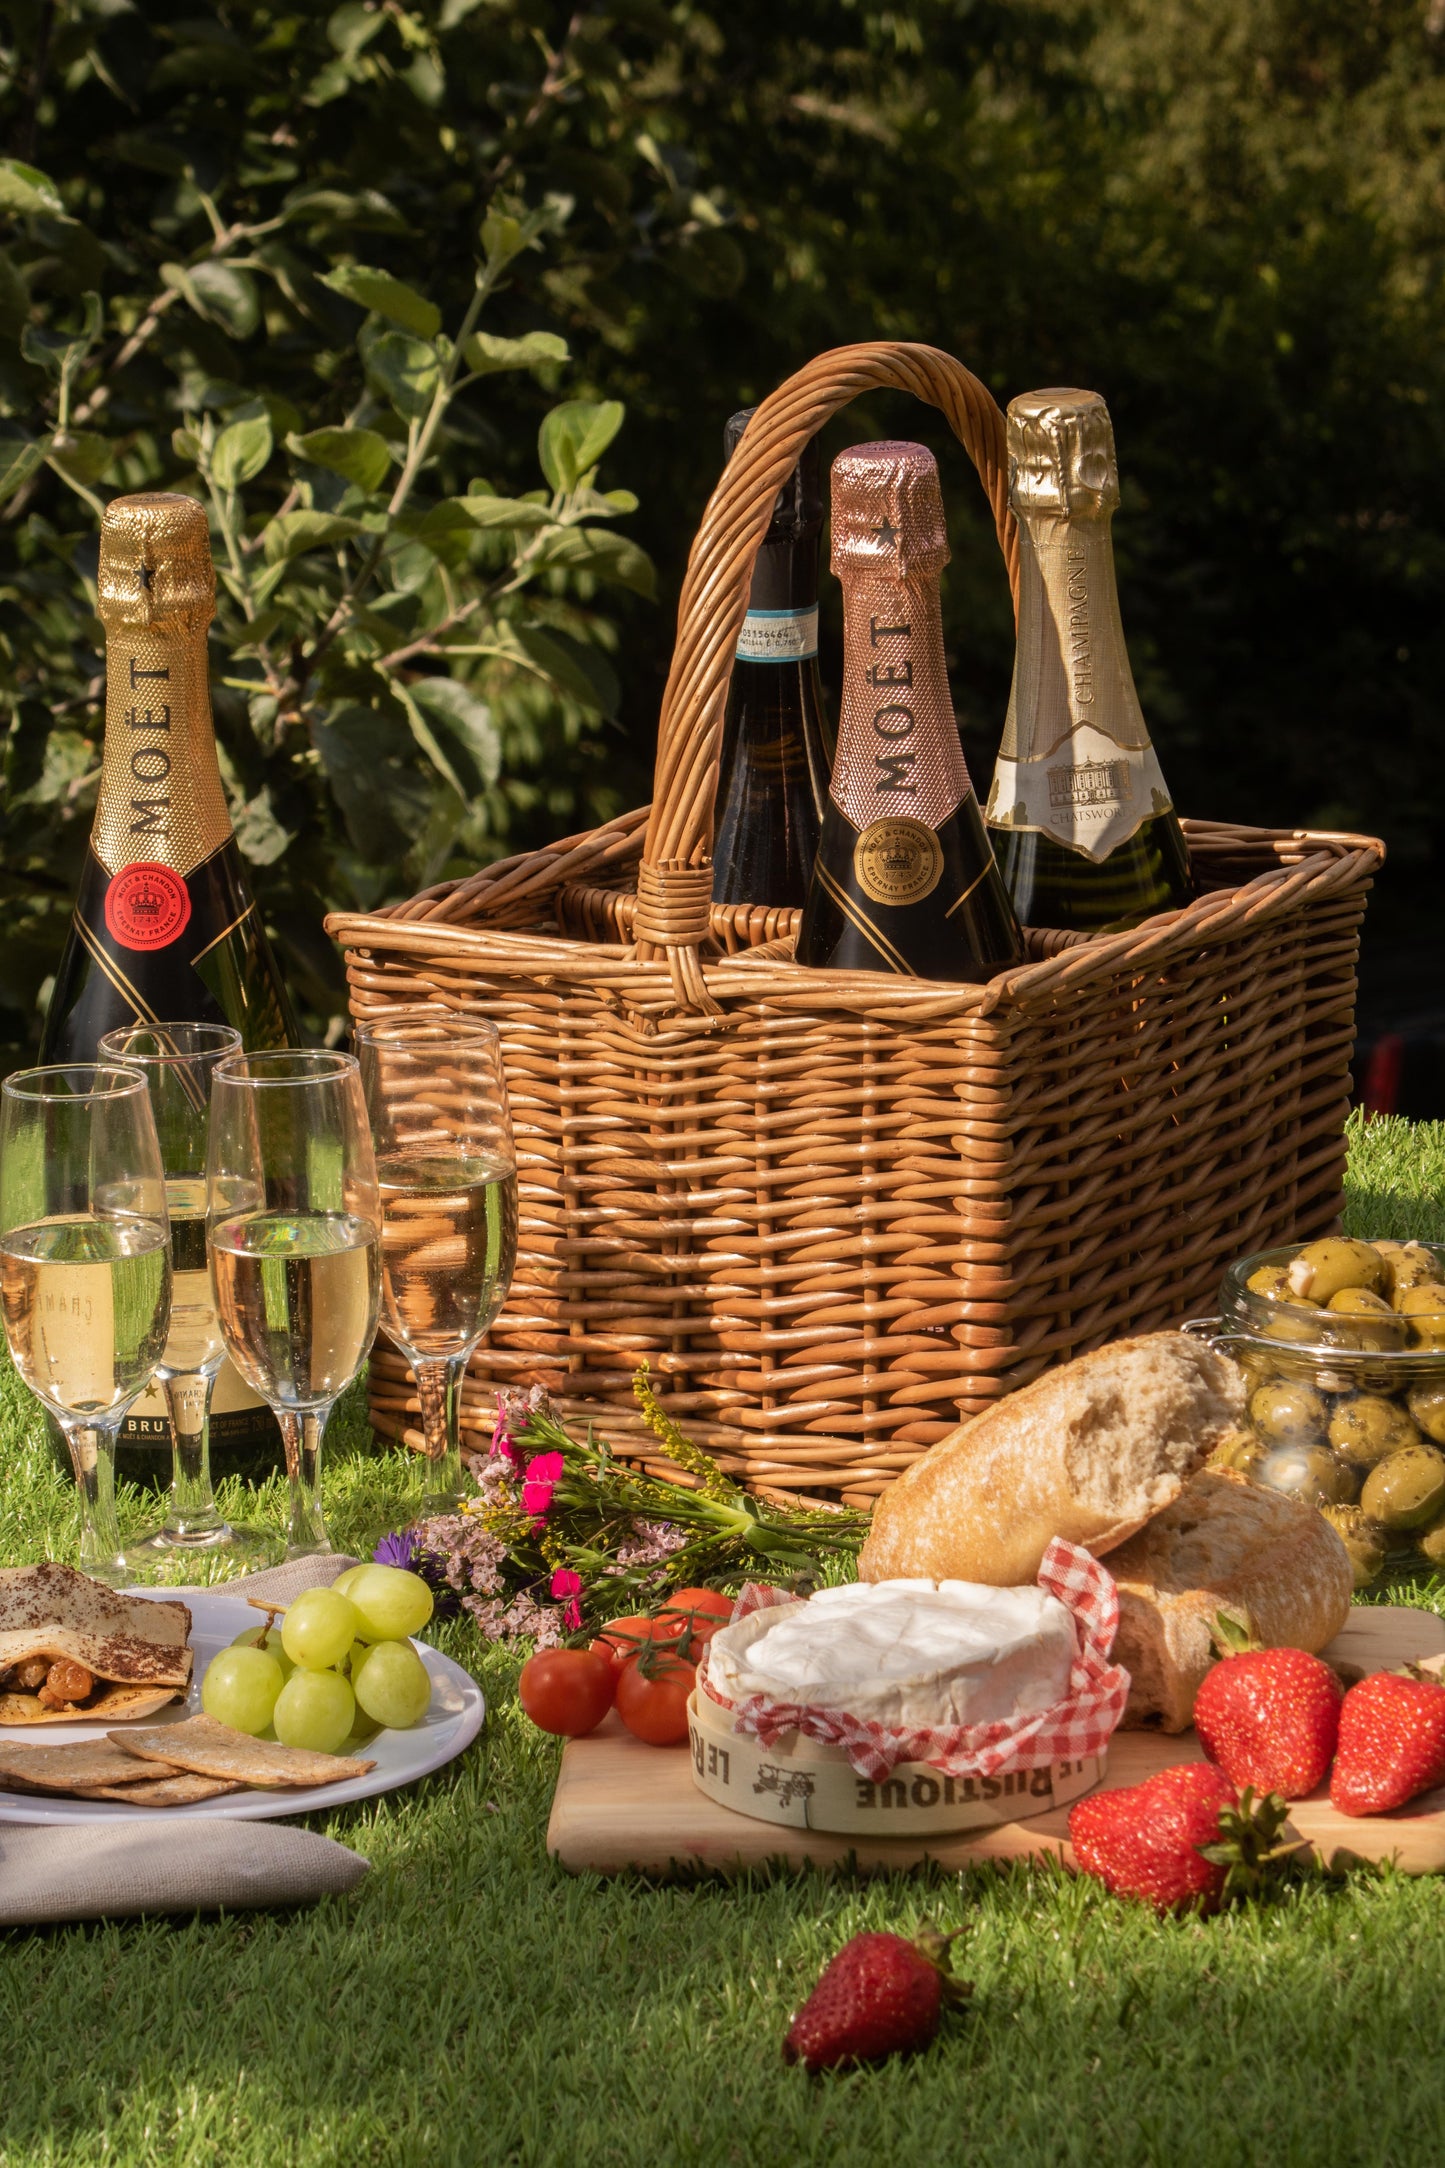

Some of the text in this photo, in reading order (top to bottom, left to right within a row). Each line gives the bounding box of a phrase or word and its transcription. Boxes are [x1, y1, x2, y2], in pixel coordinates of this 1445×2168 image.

[1067, 549, 1095, 705] CHAMPAGNE
[865, 615, 918, 796] MOËT
[124, 658, 171, 836] MOËT
[1050, 807, 1135, 825] CHATSWORT
[893, 829, 929, 853] CHANDON
[142, 874, 176, 899] CHANDON
[902, 865, 929, 891] FRANCE
[149, 911, 176, 936] FRANCE
[127, 1420, 170, 1432] BRU
[708, 1743, 729, 1785] LE
